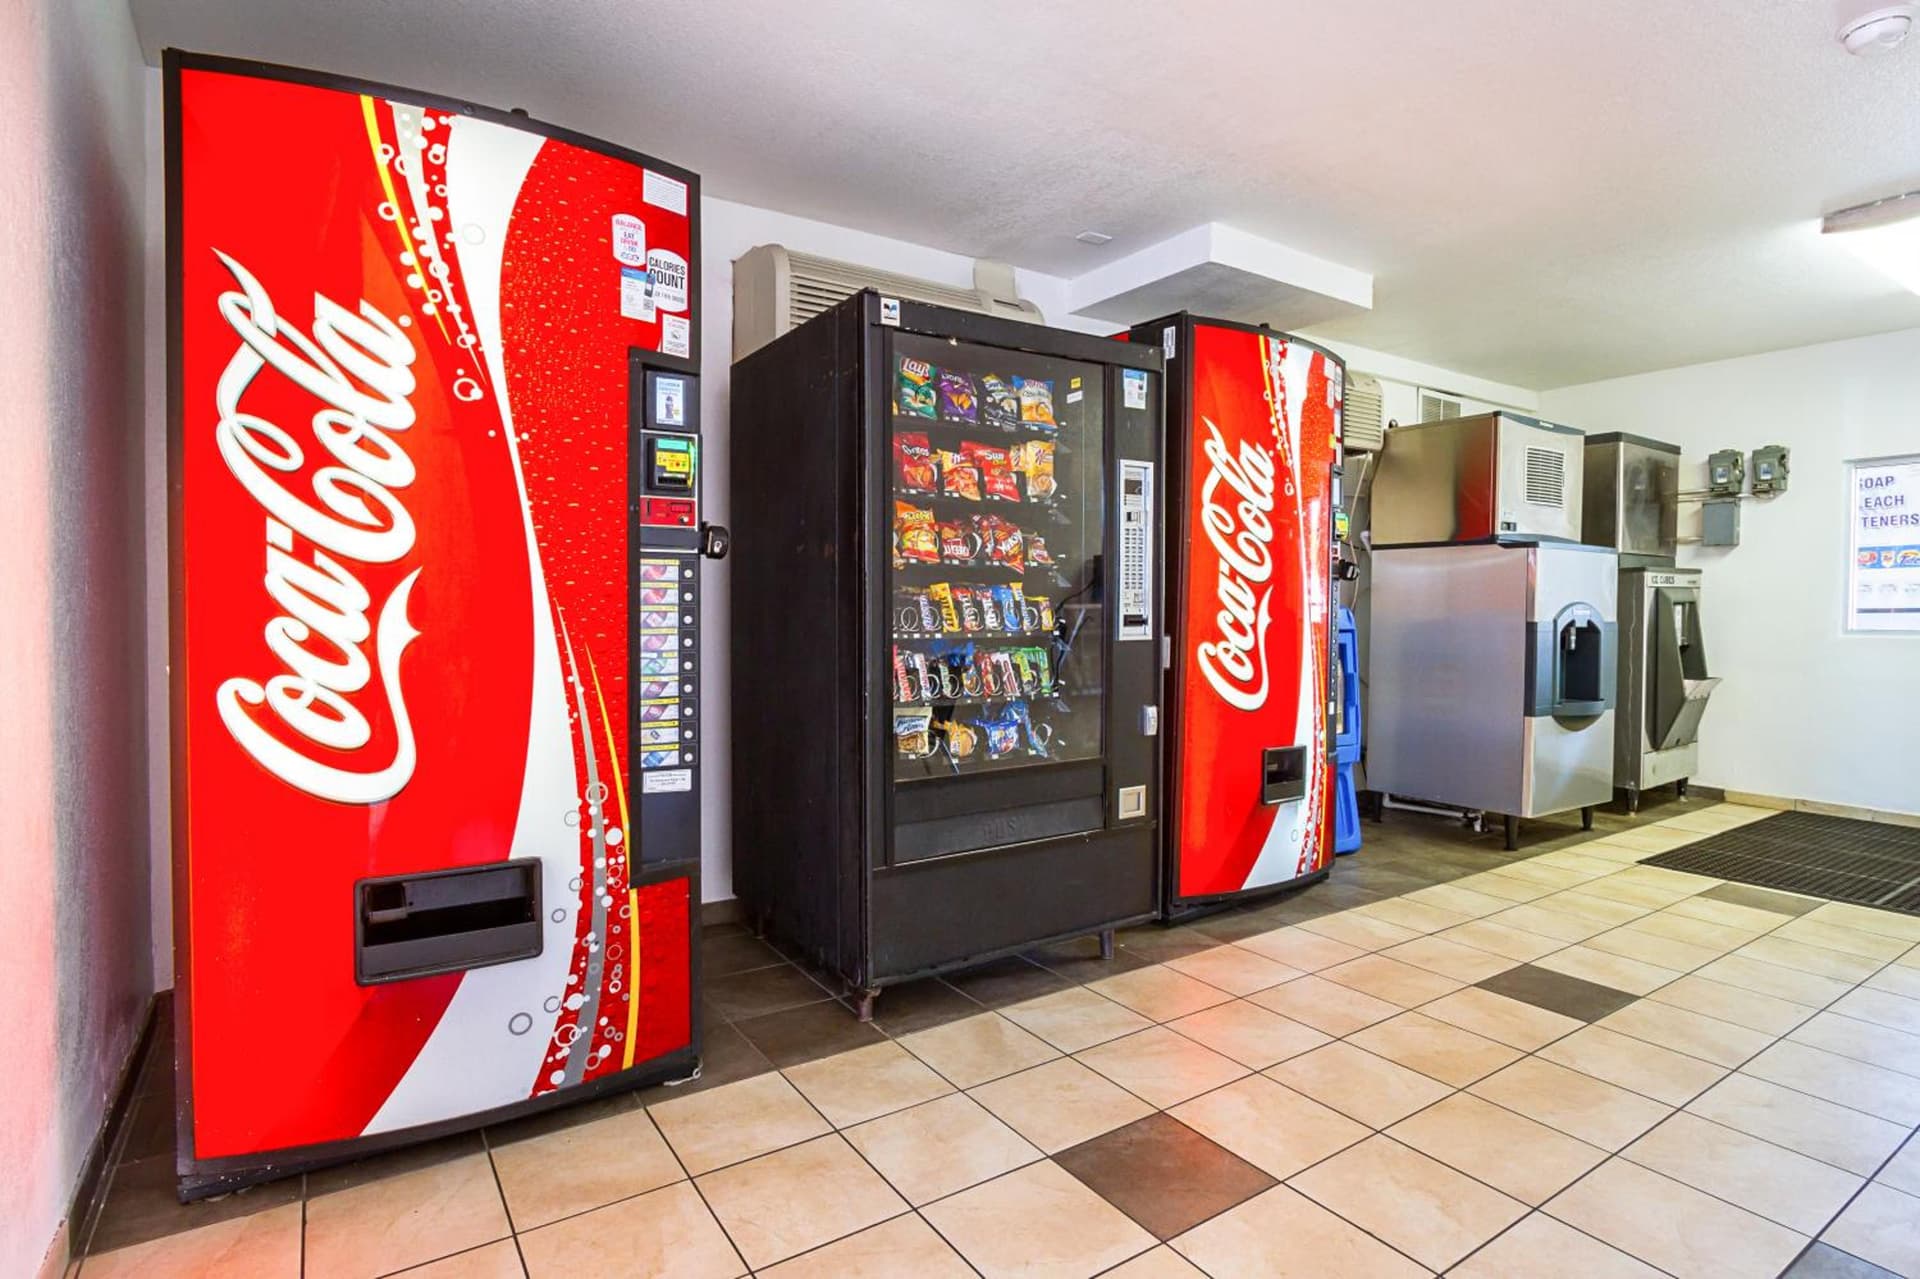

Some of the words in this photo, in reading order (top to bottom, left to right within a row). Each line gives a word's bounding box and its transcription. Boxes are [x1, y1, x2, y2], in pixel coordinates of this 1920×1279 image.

[648, 256, 686, 276] CALORIES
[210, 246, 423, 805] Coca-Cola
[1197, 415, 1276, 712] Coca-Cola
